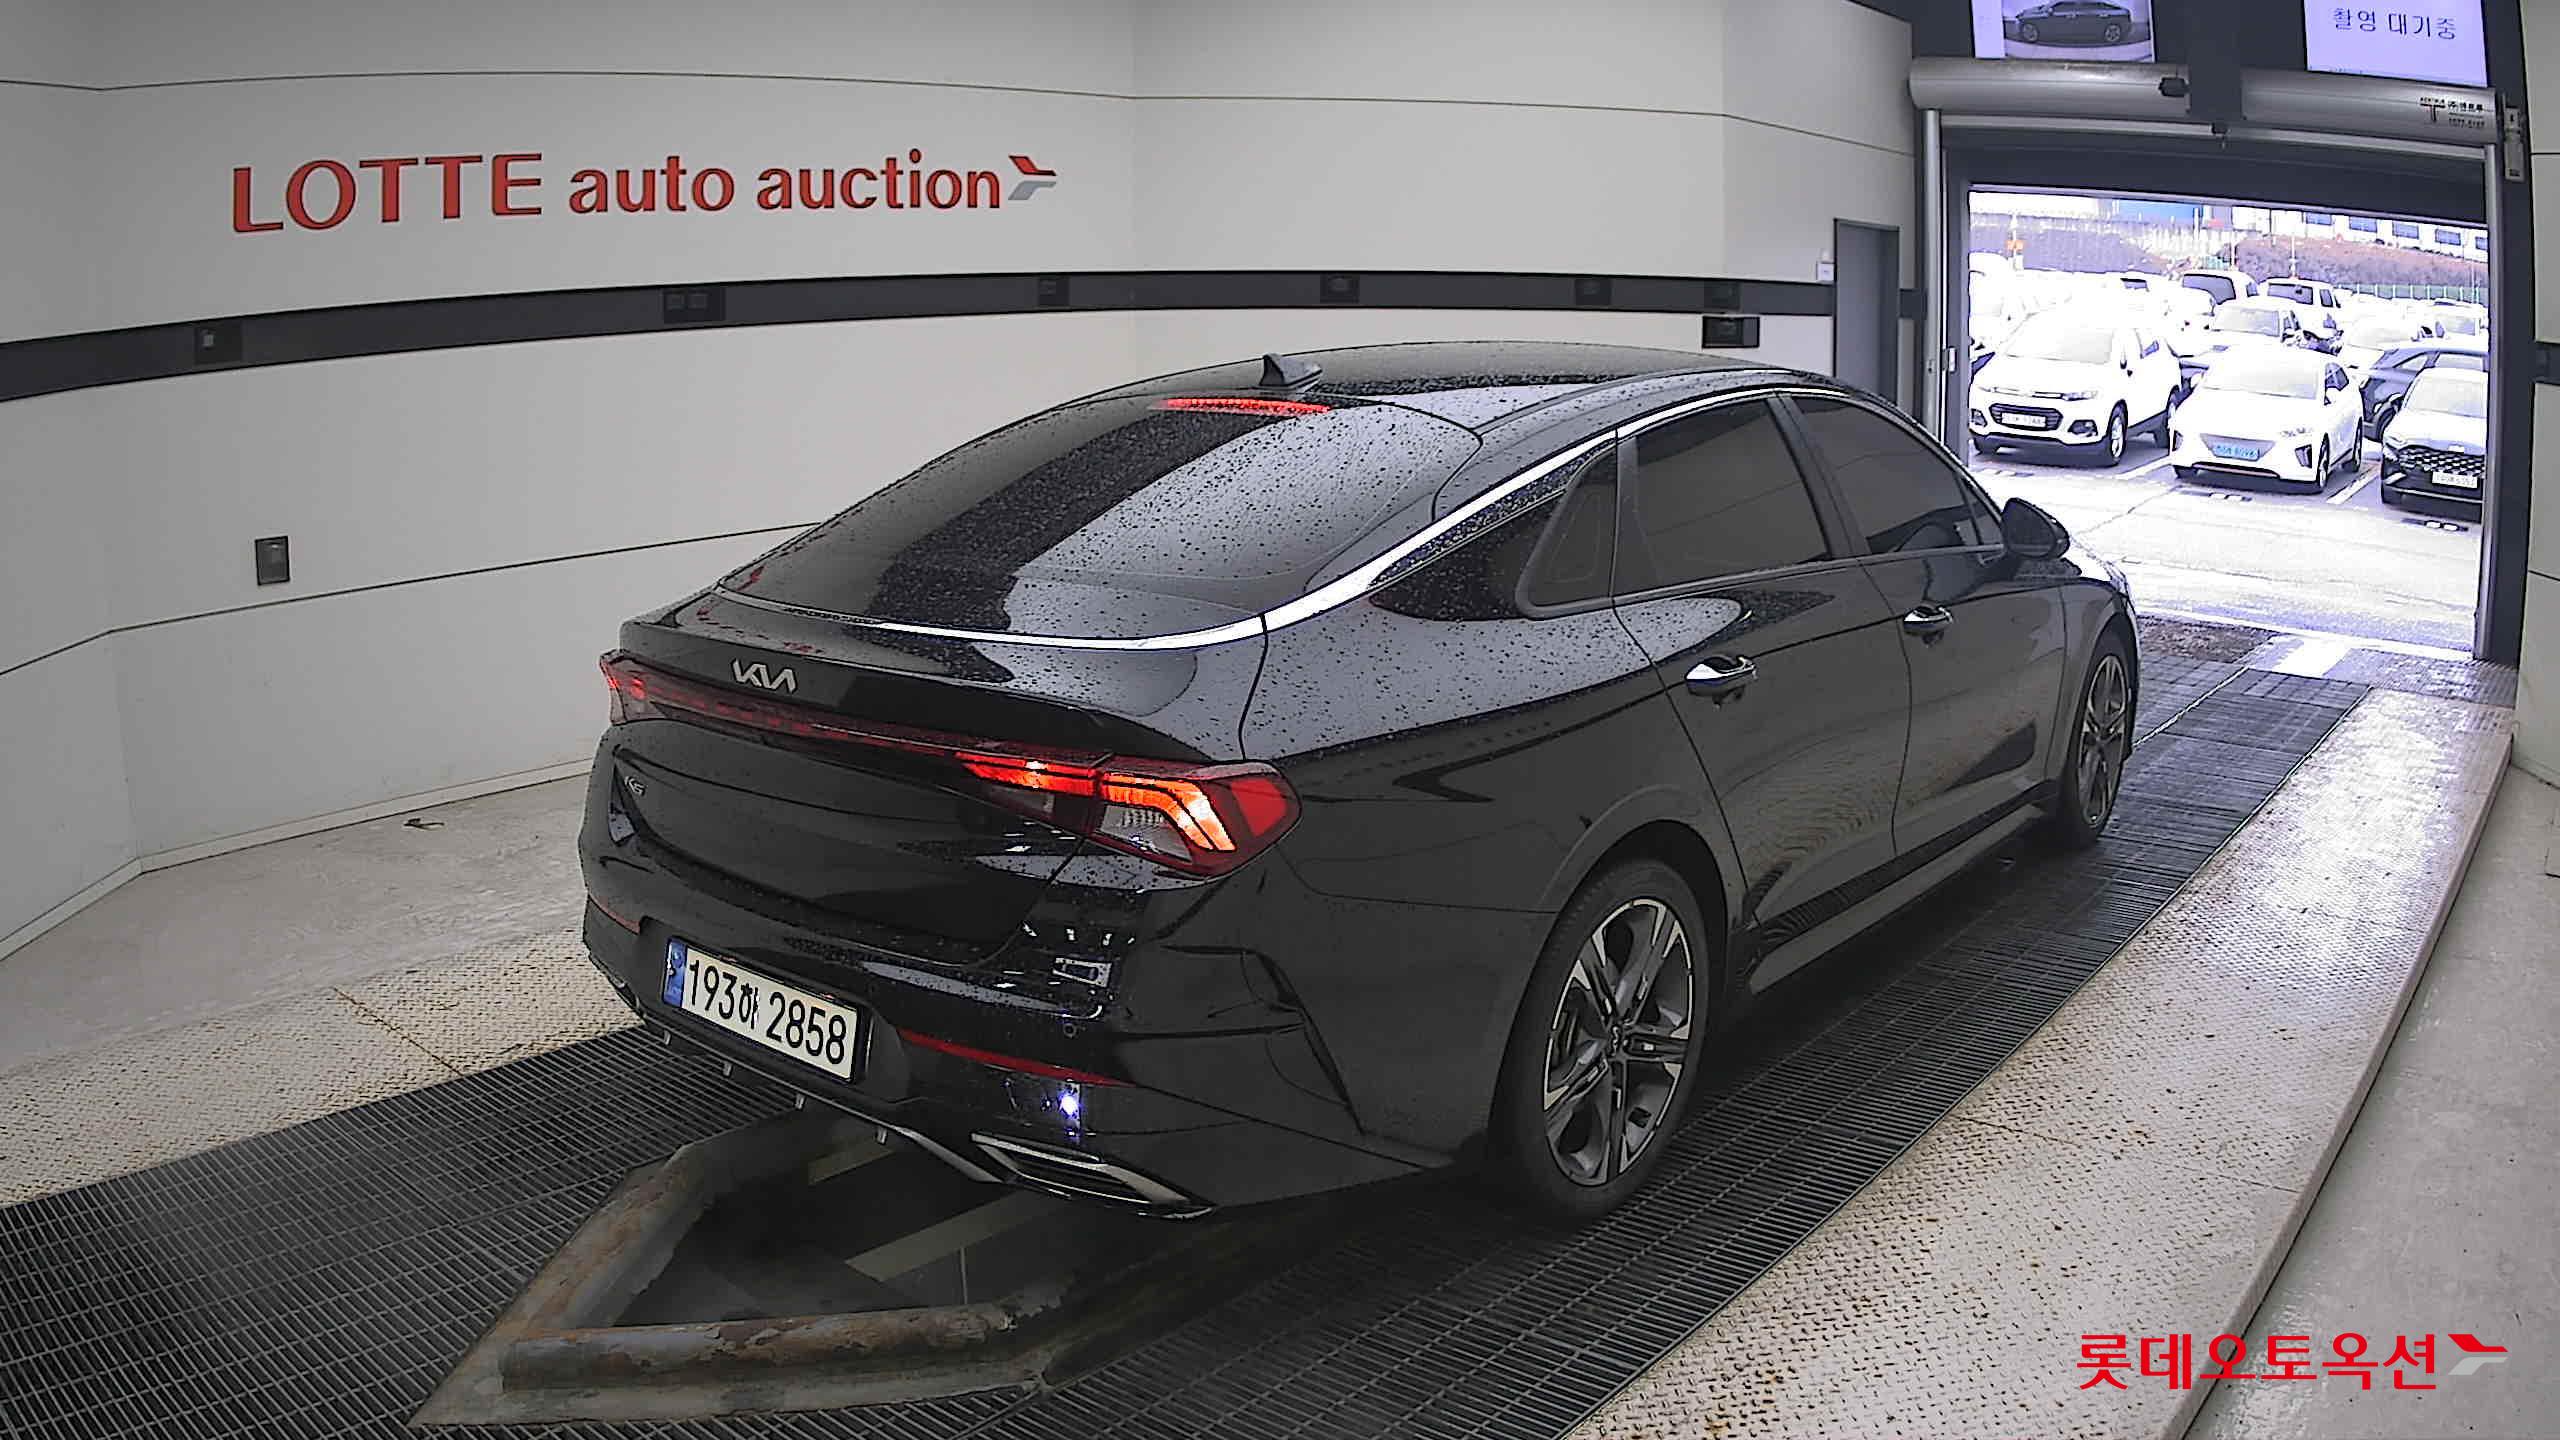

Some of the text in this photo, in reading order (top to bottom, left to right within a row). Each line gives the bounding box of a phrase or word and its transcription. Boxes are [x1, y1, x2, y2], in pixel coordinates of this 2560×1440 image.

[2334, 8, 2457, 40] 촬영 대기중
[233, 148, 1002, 232] LOTTE auto auction
[732, 658, 797, 693] KIA
[688, 959, 847, 1065] 193하 2858
